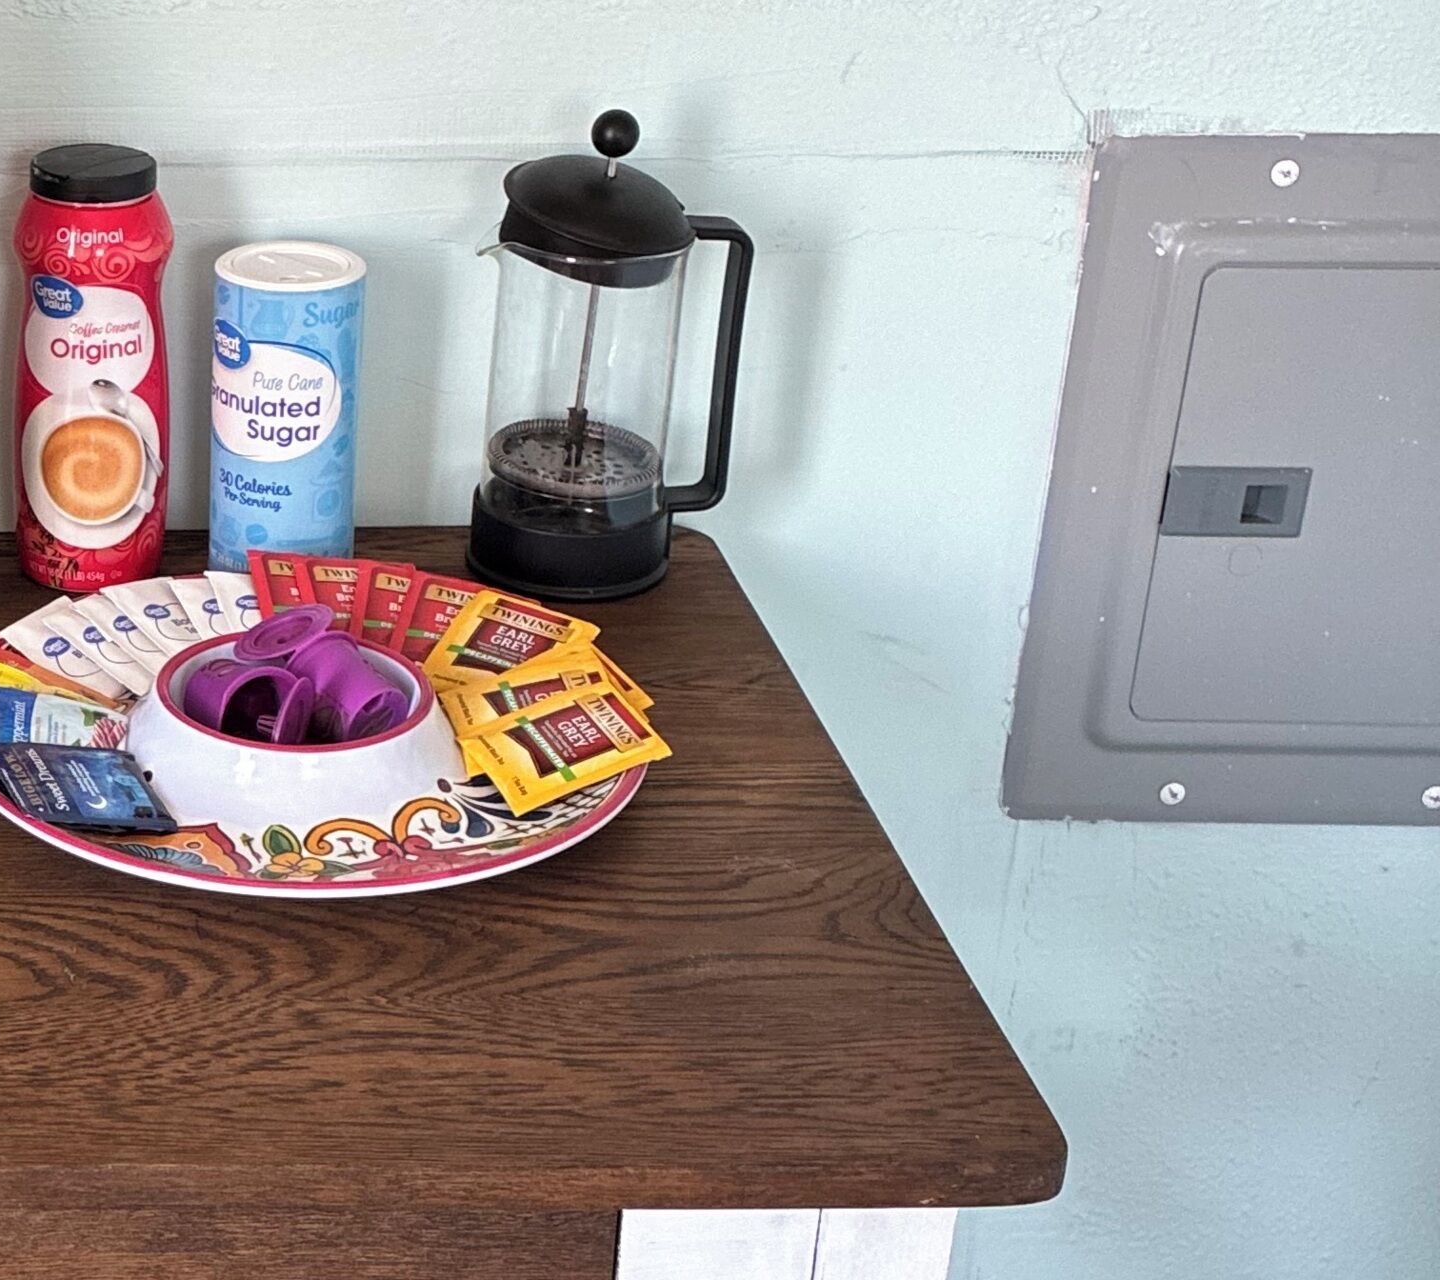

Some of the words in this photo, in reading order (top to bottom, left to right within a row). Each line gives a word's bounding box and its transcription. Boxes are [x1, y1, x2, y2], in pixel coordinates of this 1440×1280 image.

[56, 227, 124, 248] Original
[34, 281, 72, 302] Great
[42, 297, 73, 312] Value
[50, 334, 142, 365] Original
[252, 370, 283, 391] Pure
[288, 373, 324, 391] Cane
[247, 418, 321, 448] Sugar
[219, 467, 234, 487] 30
[235, 473, 293, 497] Calories
[224, 486, 239, 502] Per
[239, 492, 283, 513] Serving
[321, 567, 359, 580] TWIN
[436, 587, 477, 603] TWIN
[492, 607, 564, 636] TWININGS
[496, 625, 536, 646] EARL
[490, 635, 533, 654] GREY
[13, 700, 28, 743] ppermint
[557, 720, 590, 748] GREY
[571, 715, 601, 744] EARL
[587, 697, 638, 745] TWININGS
[26, 748, 55, 782] Dreams
[46, 782, 71, 812] Sweet
